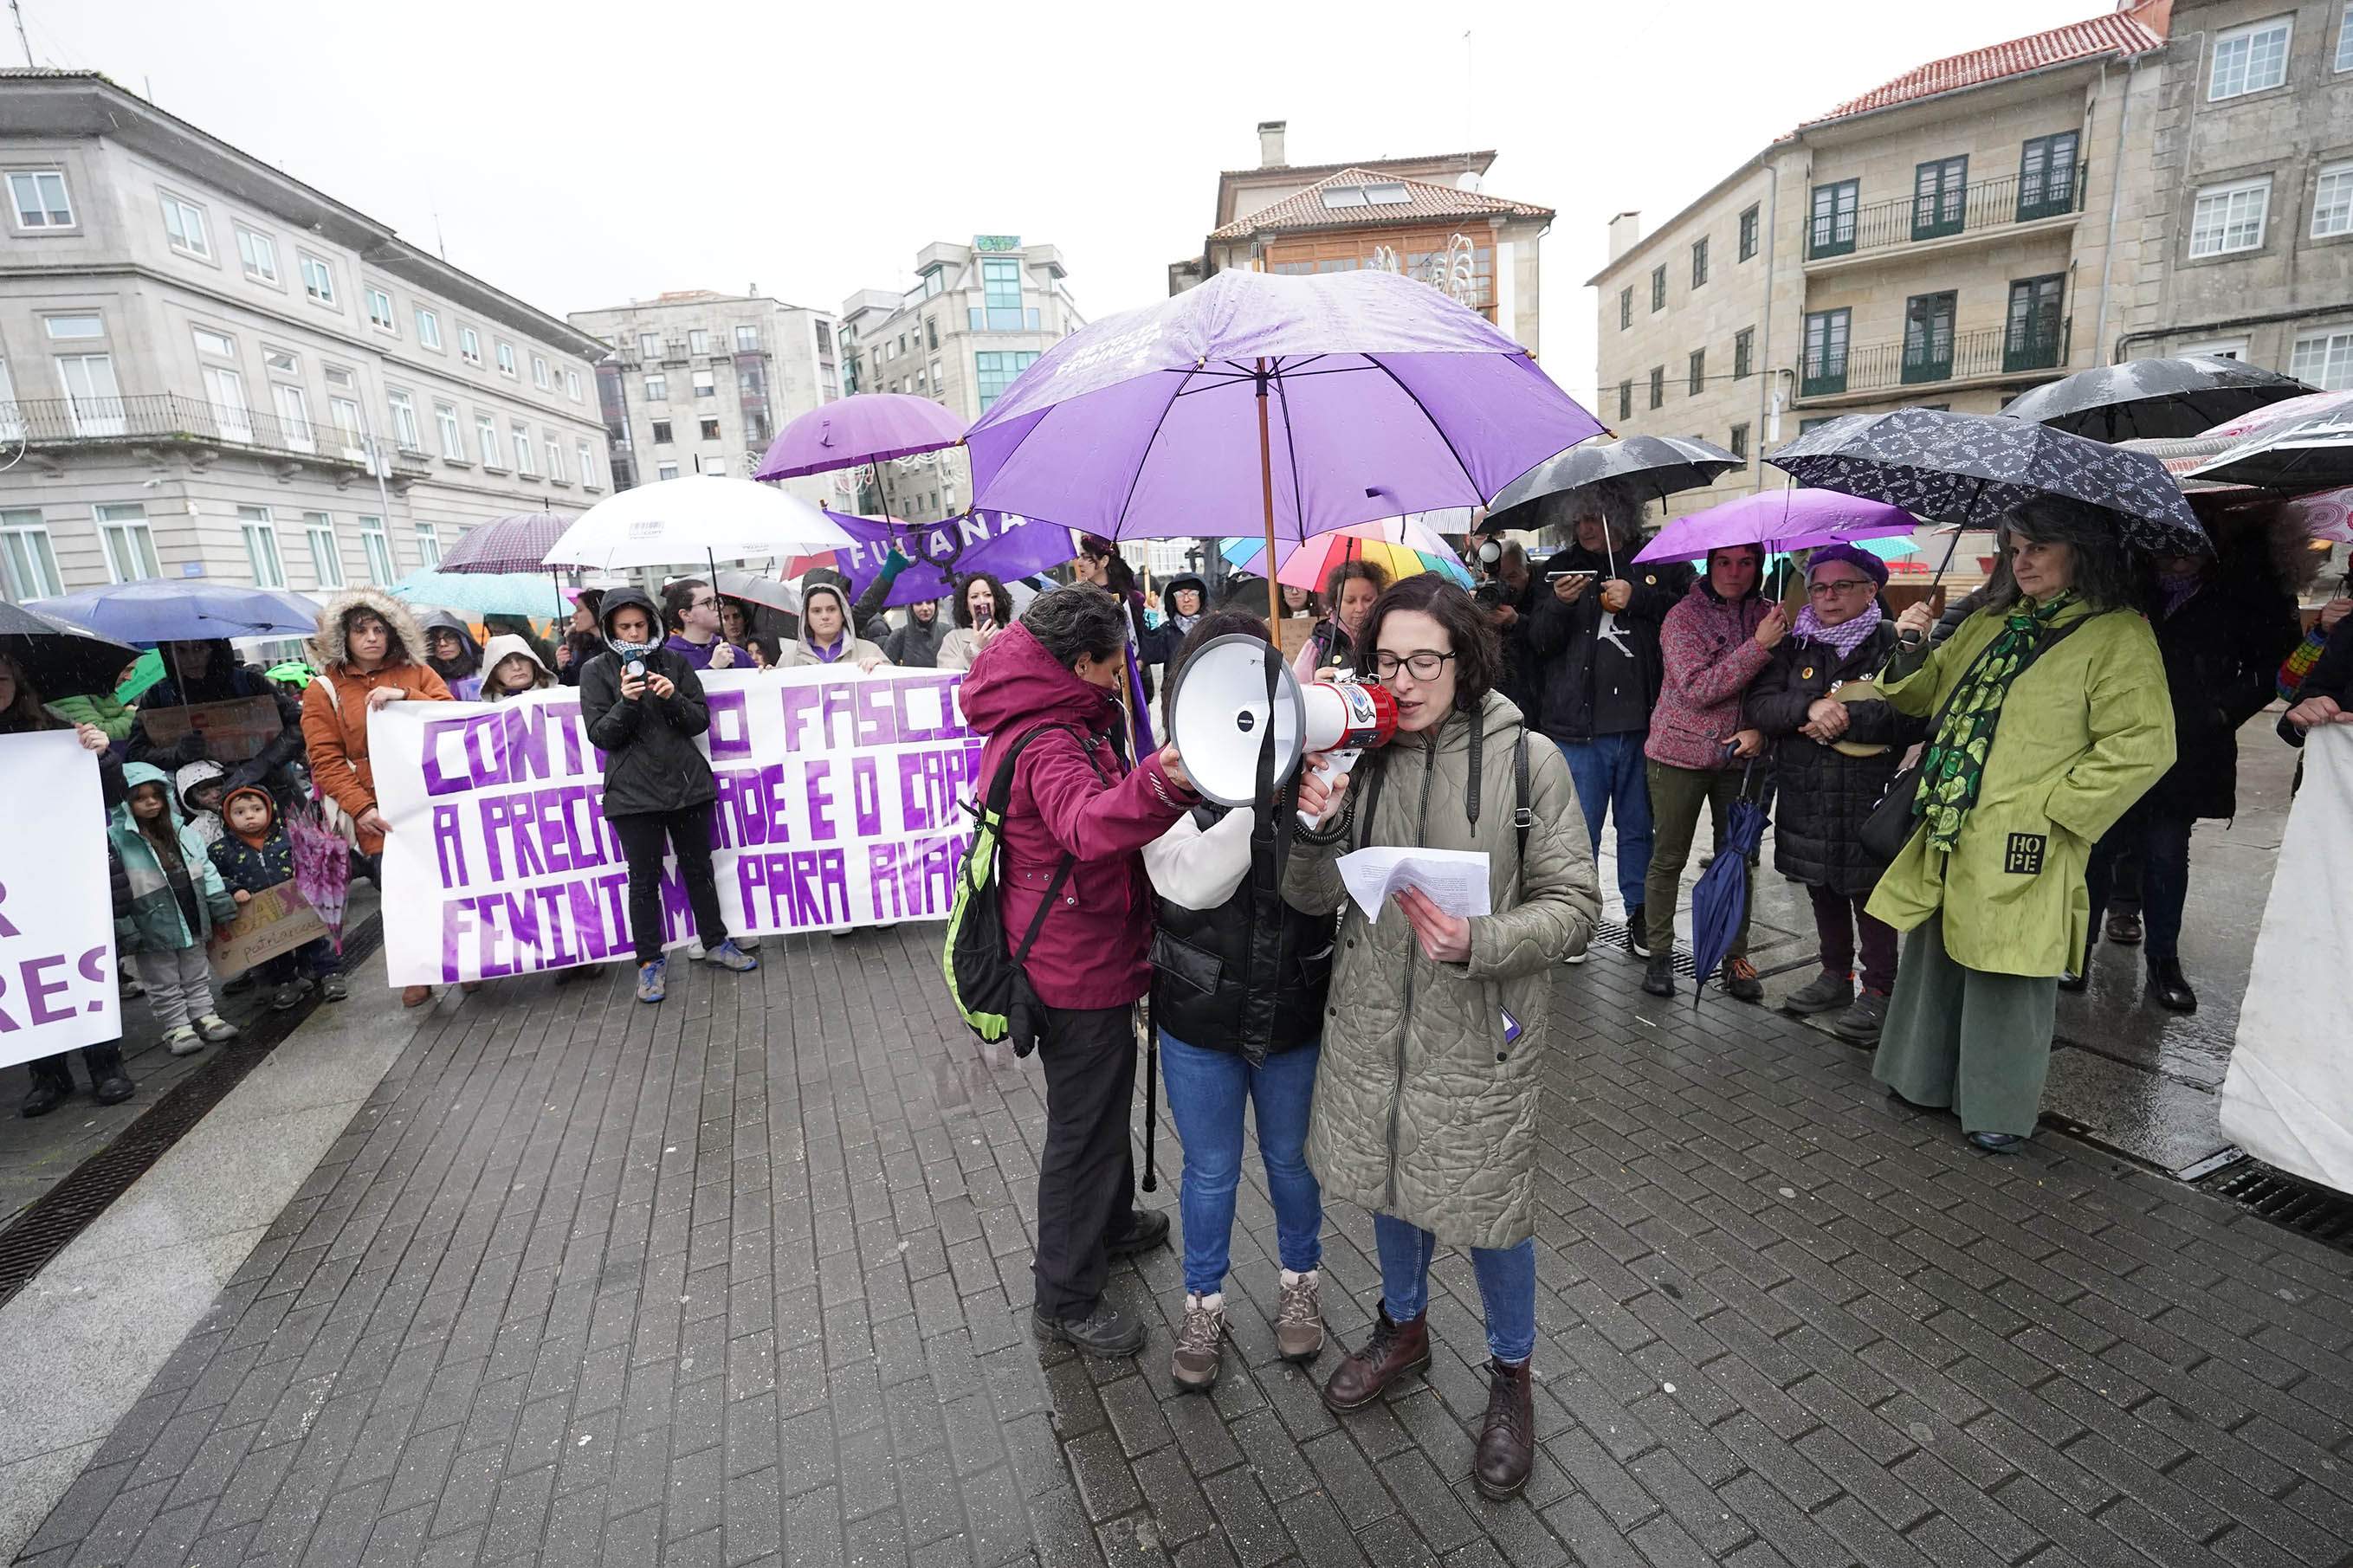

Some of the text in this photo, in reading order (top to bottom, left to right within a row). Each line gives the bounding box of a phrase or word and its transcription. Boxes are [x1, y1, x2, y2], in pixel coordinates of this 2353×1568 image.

[422, 672, 992, 796] CONT O FASCI
[433, 803, 470, 890] A
[805, 759, 837, 841] E
[852, 756, 882, 836] O
[738, 848, 850, 929] PARA
[869, 832, 973, 920] AVAN
